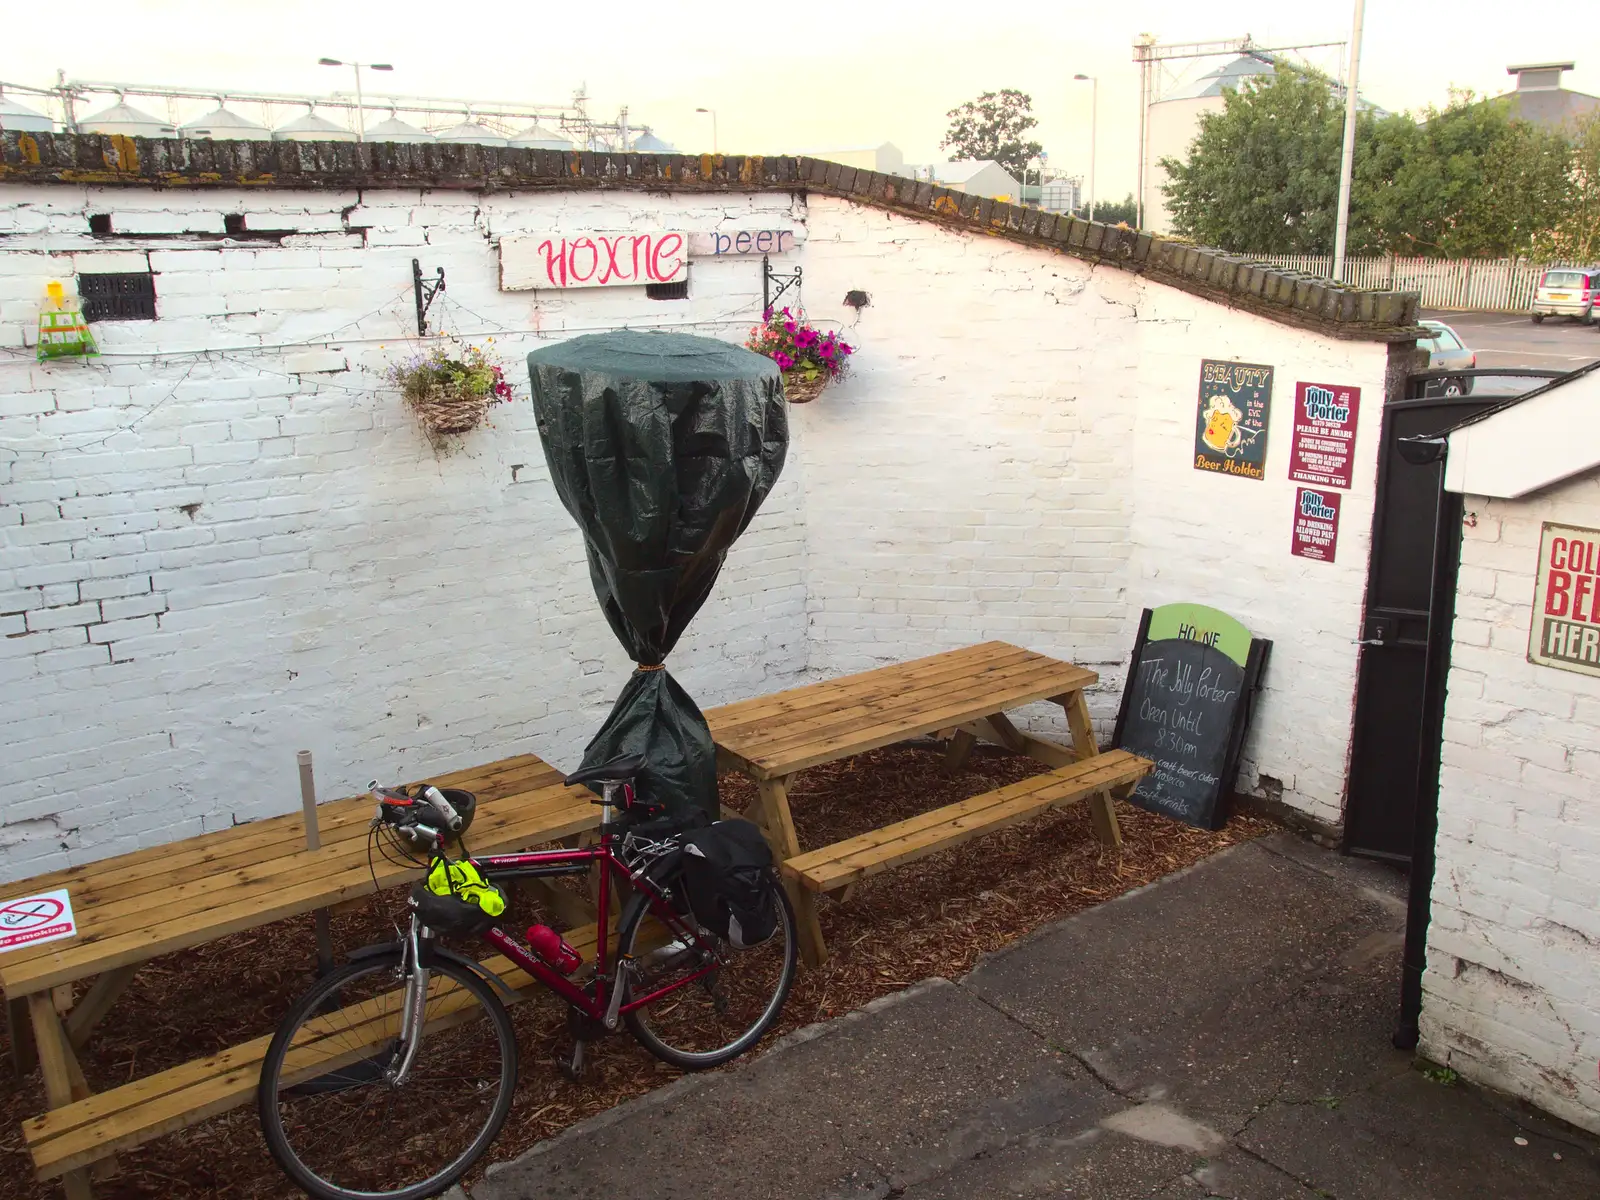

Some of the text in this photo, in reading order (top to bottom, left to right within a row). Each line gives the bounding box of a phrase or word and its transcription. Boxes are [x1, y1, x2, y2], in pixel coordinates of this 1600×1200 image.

[1204, 364, 1269, 392] BEAUTY
[1253, 390, 1259, 398] is
[1305, 388, 1333, 407] Jolly
[1253, 400, 1264, 409] the
[1310, 404, 1349, 421] Porter
[1244, 418, 1263, 427] of the
[1296, 425, 1352, 438] PLEASE BE AWARE
[1195, 455, 1261, 477] Beer Holder
[1293, 472, 1347, 485] THANKING YOU
[1302, 491, 1323, 507] Jolly
[1305, 504, 1335, 519] Porter
[1296, 526, 1335, 539] ALLOWED PAST
[1307, 520, 1333, 531] DRINKING
[1299, 534, 1311, 543] THIS
[1547, 621, 1600, 663] HER
[1142, 658, 1236, 706] The Jolly Porter
[1140, 697, 1203, 736] Open Until
[1157, 758, 1177, 771] craft
[1198, 772, 1219, 785] cider
[1159, 796, 1190, 815] drinks
[15, 926, 67, 941] smoking
